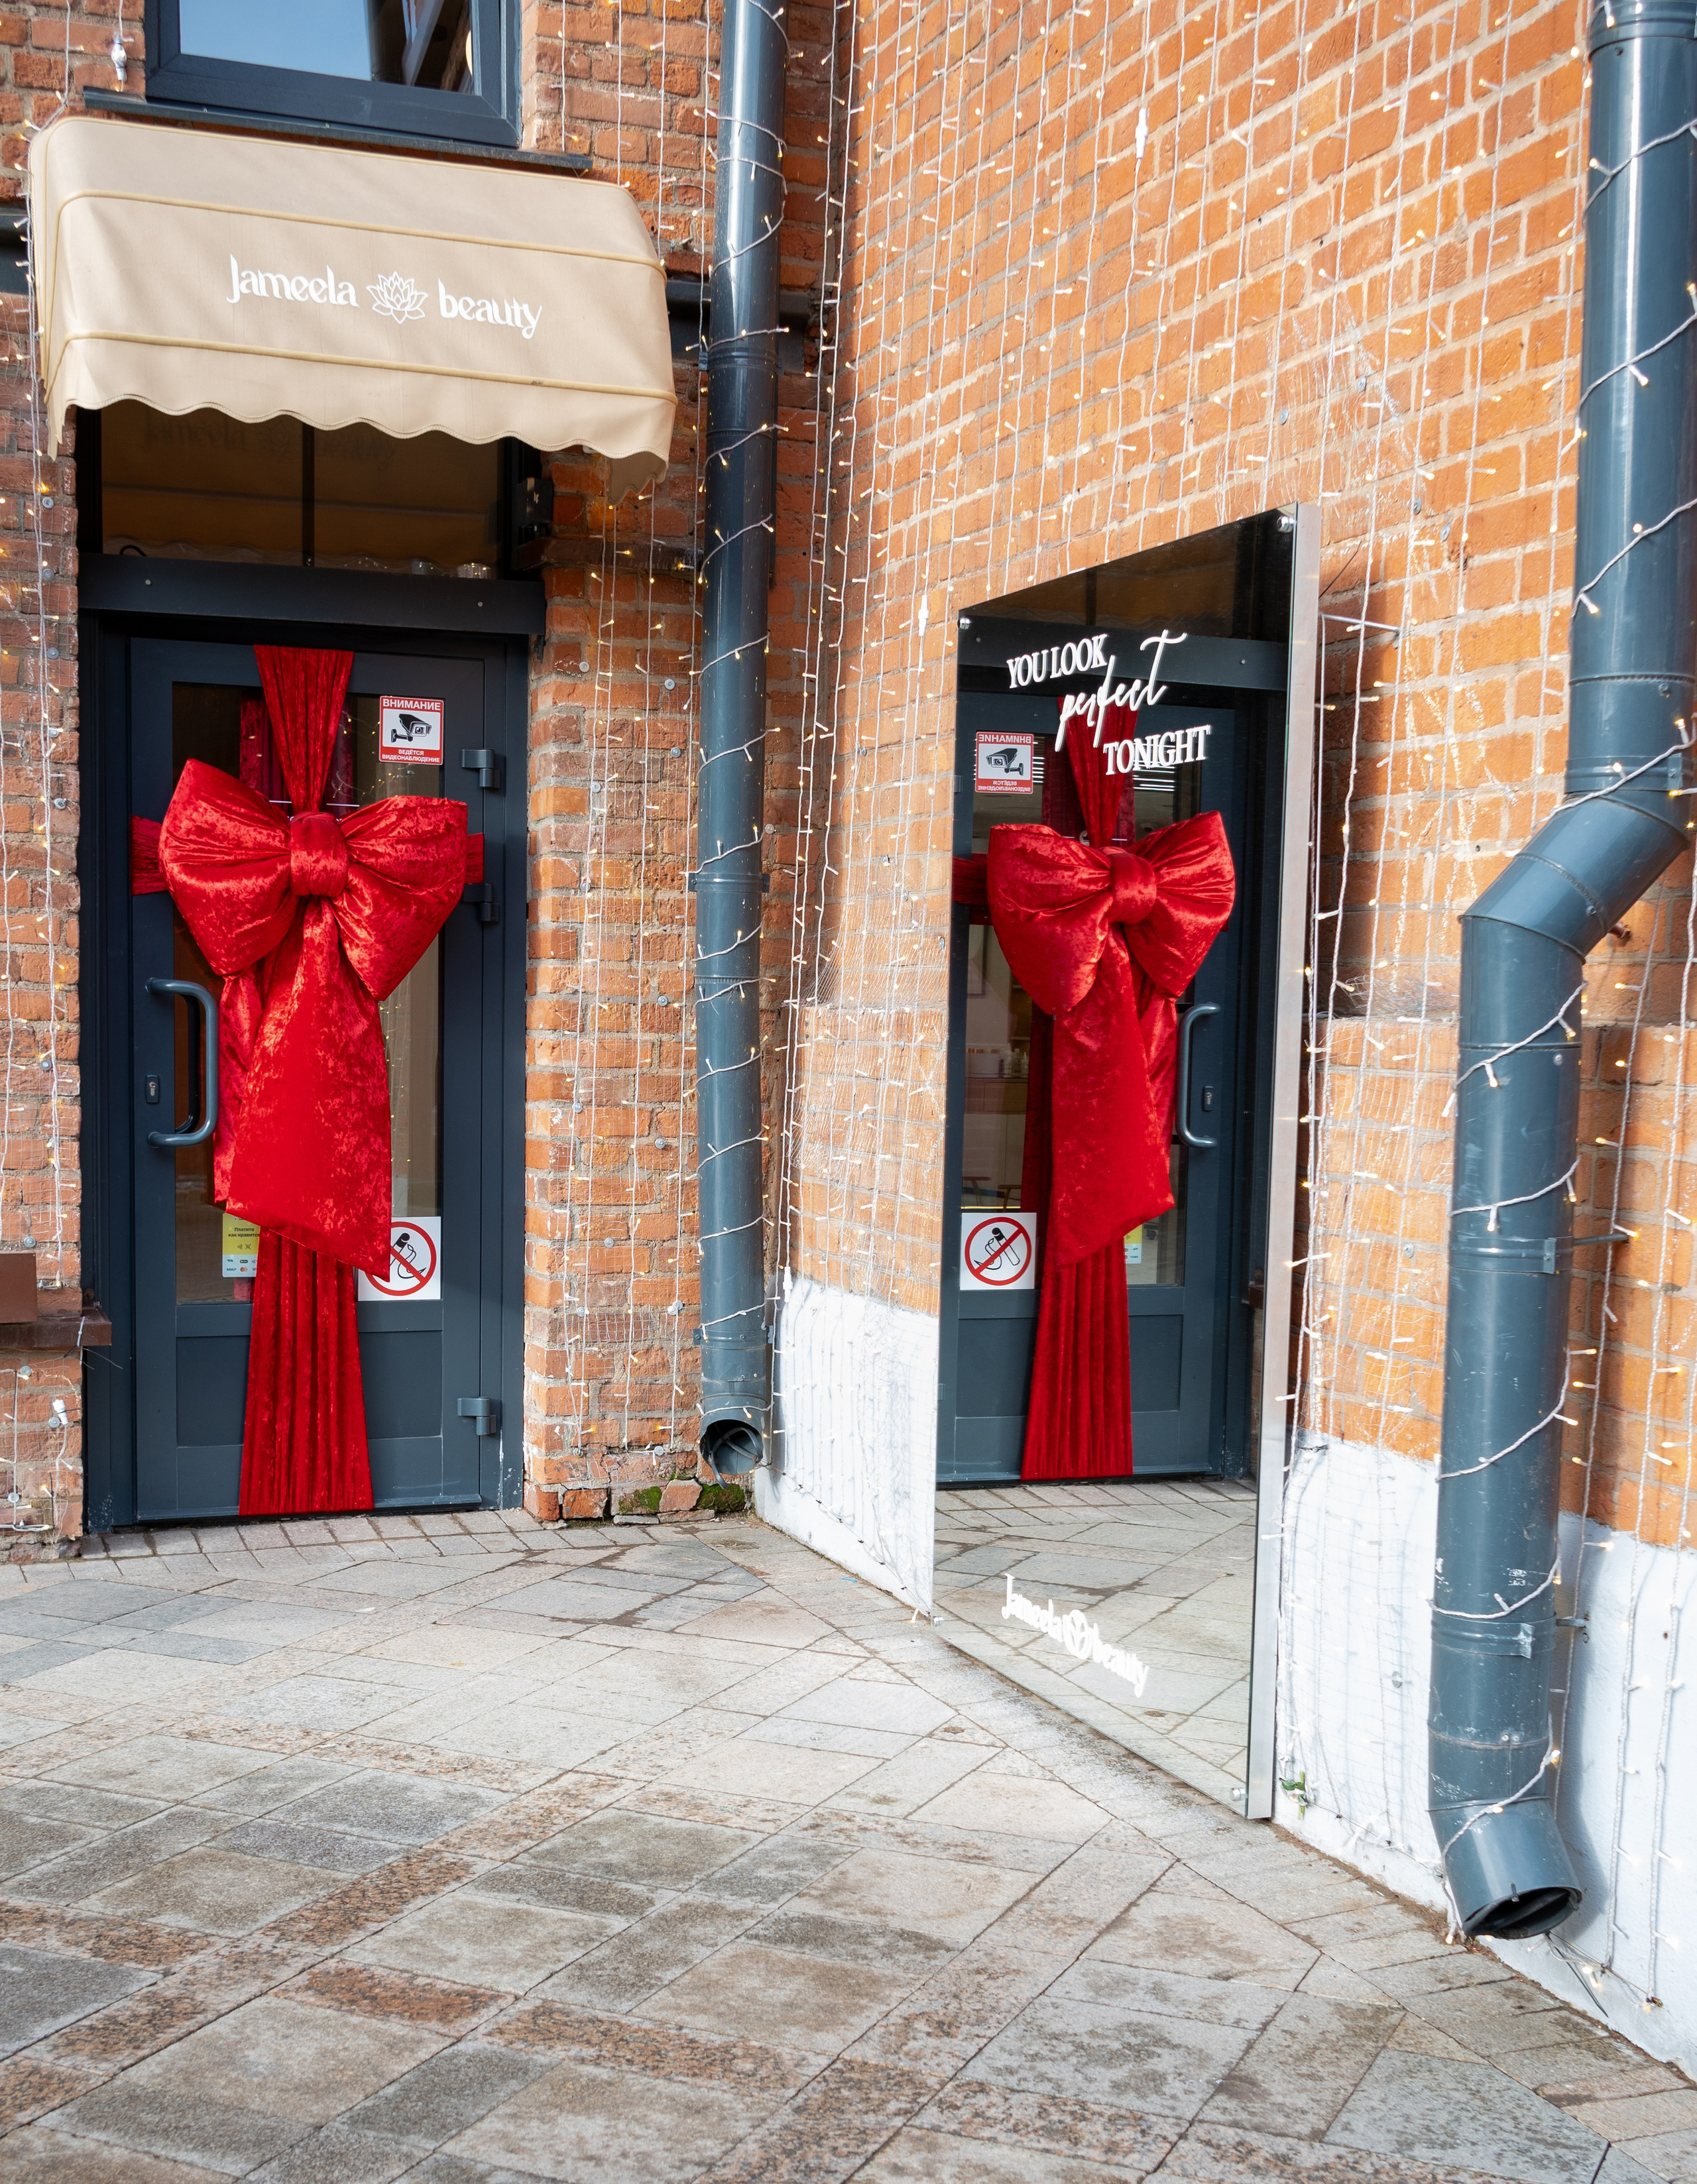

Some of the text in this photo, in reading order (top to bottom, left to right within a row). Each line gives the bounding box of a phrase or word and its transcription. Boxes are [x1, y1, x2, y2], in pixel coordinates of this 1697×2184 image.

[225, 253, 542, 339] Jameela beauty
[1006, 633, 1108, 689] YOU LOOK
[382, 699, 441, 711] ВНИМАНИЕ
[1055, 629, 1188, 752] perfect
[382, 754, 440, 763] ВИДЕОНАБЛЮДЕНИЕ
[1103, 724, 1212, 776] TONIGHT
